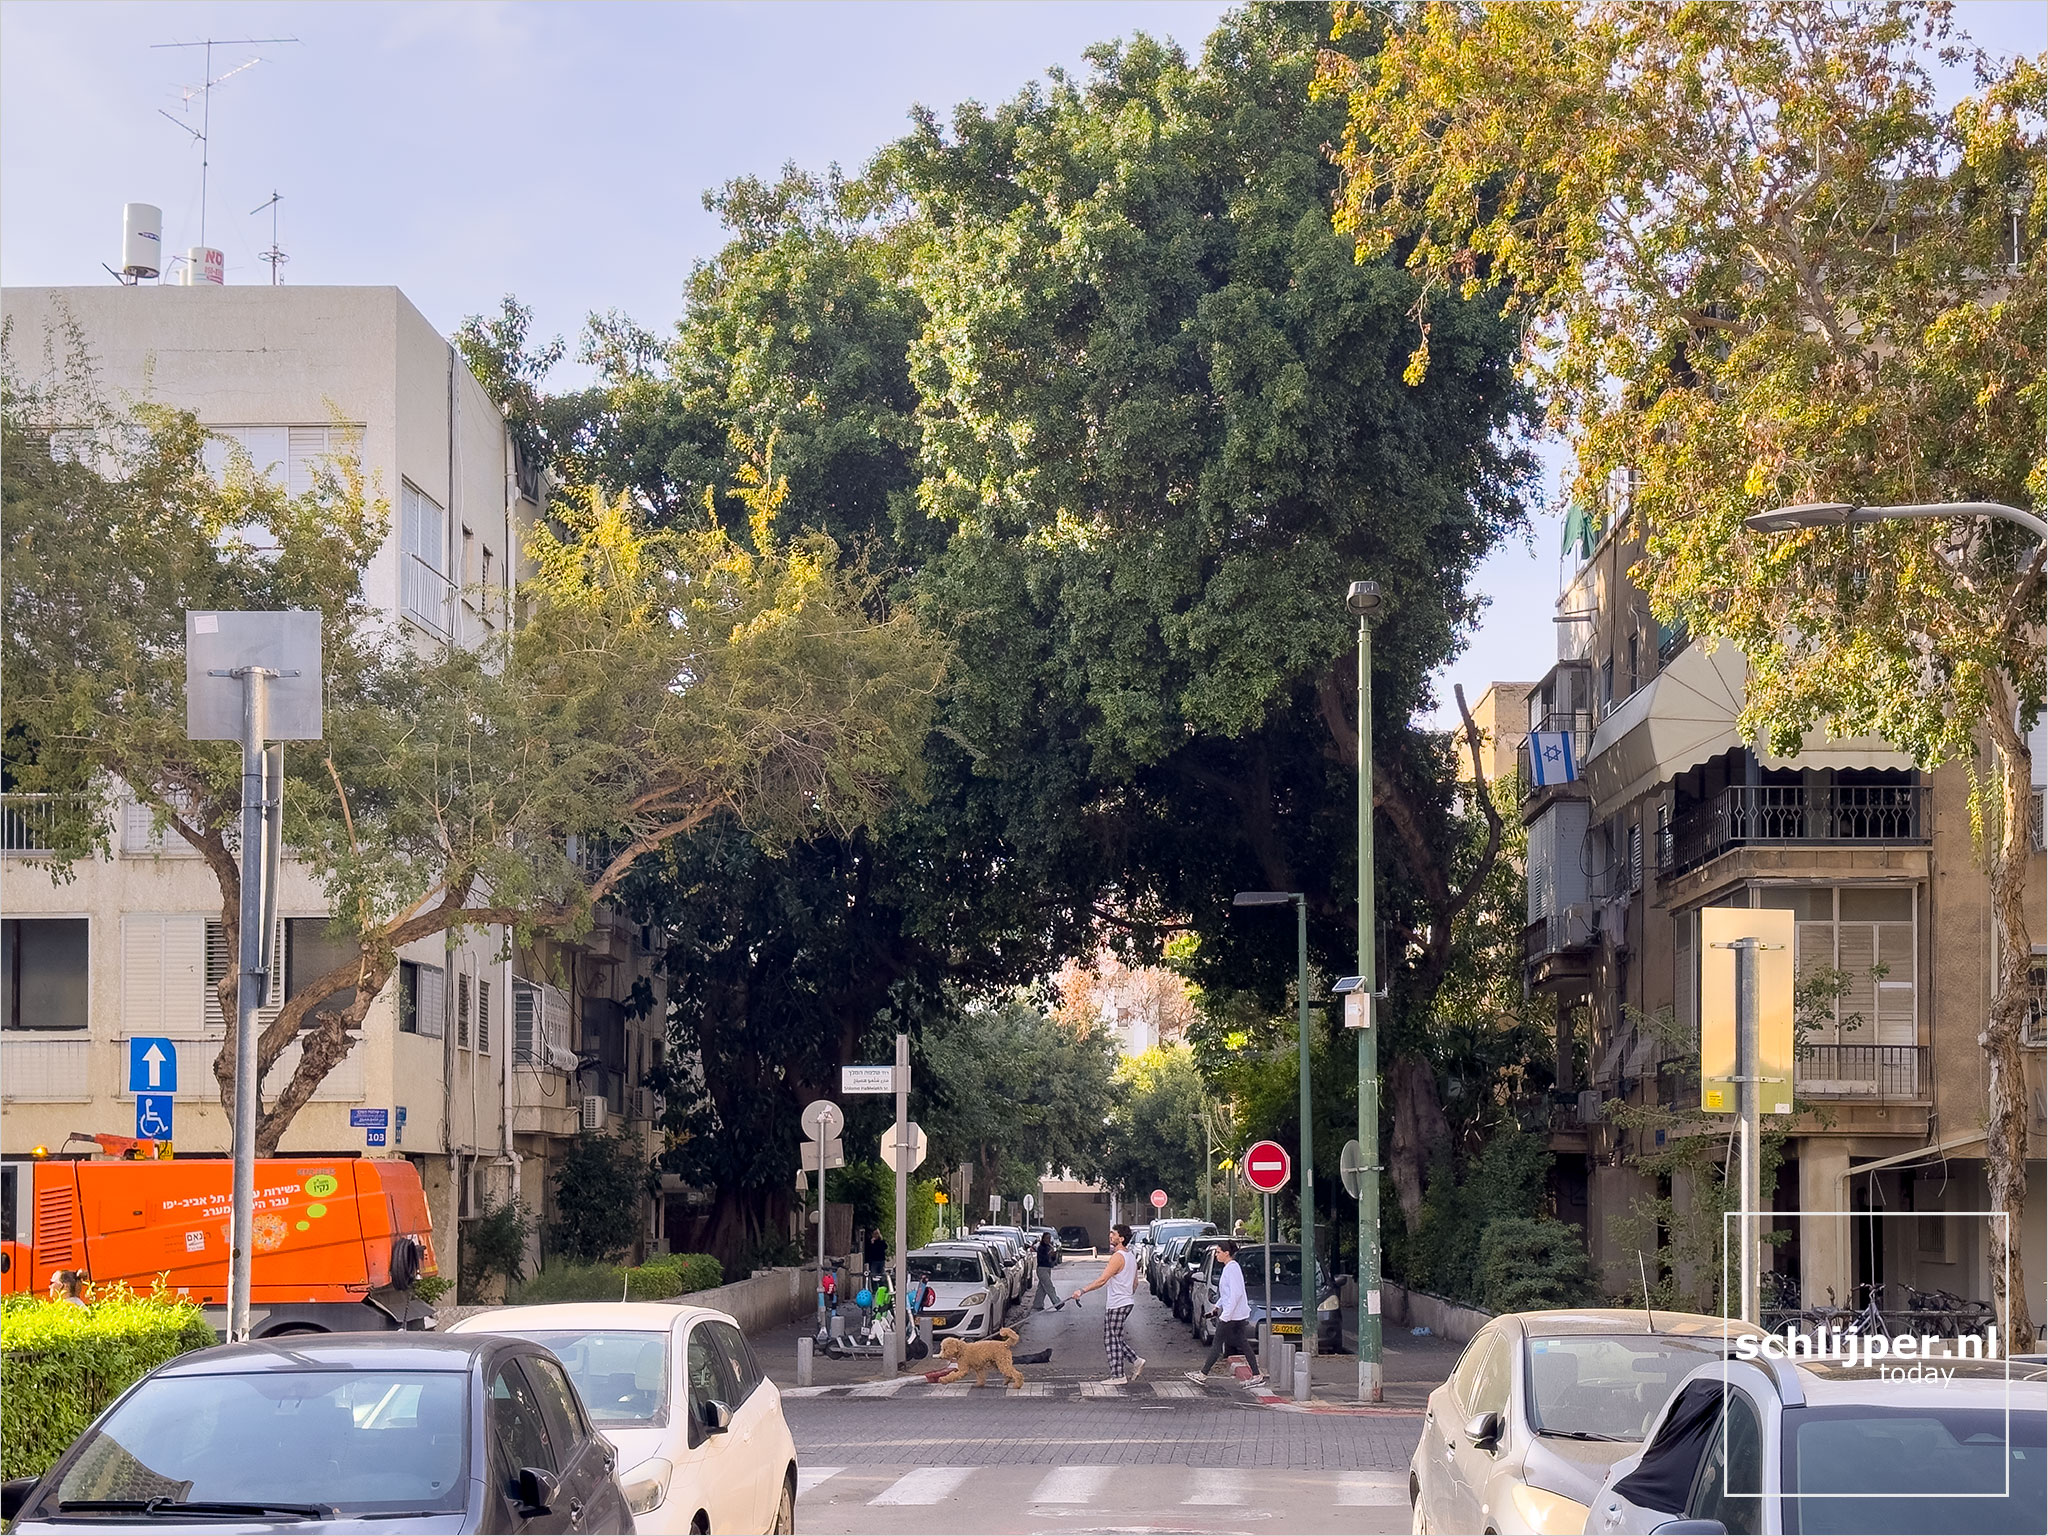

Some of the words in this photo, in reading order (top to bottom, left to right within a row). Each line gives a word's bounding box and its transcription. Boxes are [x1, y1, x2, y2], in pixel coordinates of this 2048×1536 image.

[368, 1133, 385, 1142] 103
[263, 1184, 301, 1198] בשירות
[162, 1196, 207, 1210] אביב-יפו
[209, 1194, 225, 1204] תל
[269, 1196, 289, 1207] עבר
[202, 1205, 231, 1217] מערב
